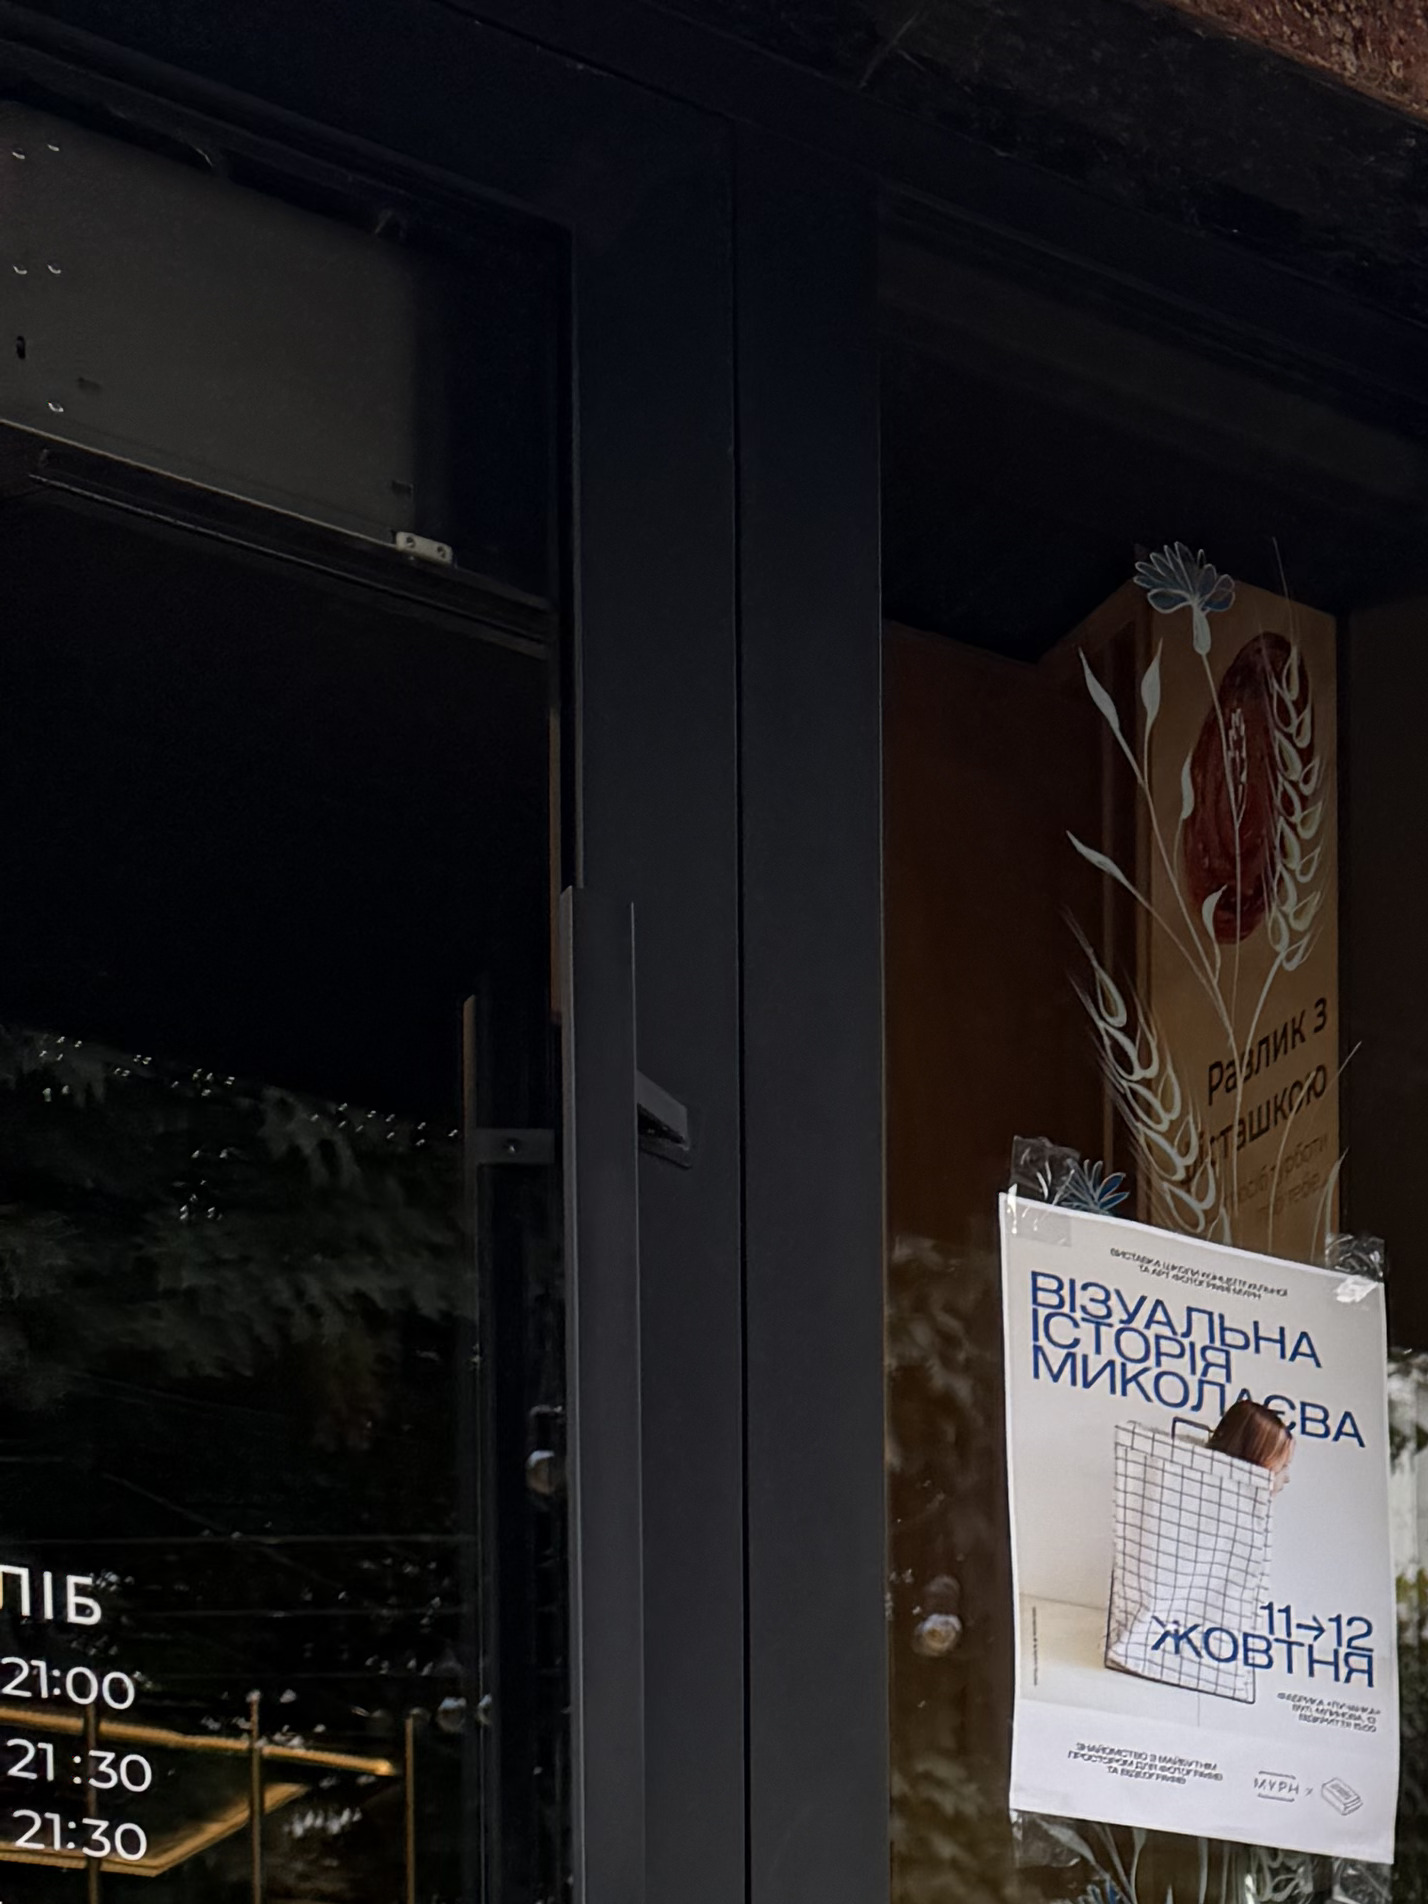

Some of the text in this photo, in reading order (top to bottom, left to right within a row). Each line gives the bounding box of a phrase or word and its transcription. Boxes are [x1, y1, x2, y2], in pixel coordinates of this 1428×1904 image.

[1031, 1271, 1322, 1369] ВІЗУАЛЬНА
[1032, 1307, 1232, 1383] ІСТОРІЯ
[1033, 1345, 1366, 1448] МИКОЛЄВА
[0, 1656, 136, 1710] 21:00
[1151, 1615, 1375, 1688] ЖОВТНЯ
[12, 1809, 148, 1861] 21:30
